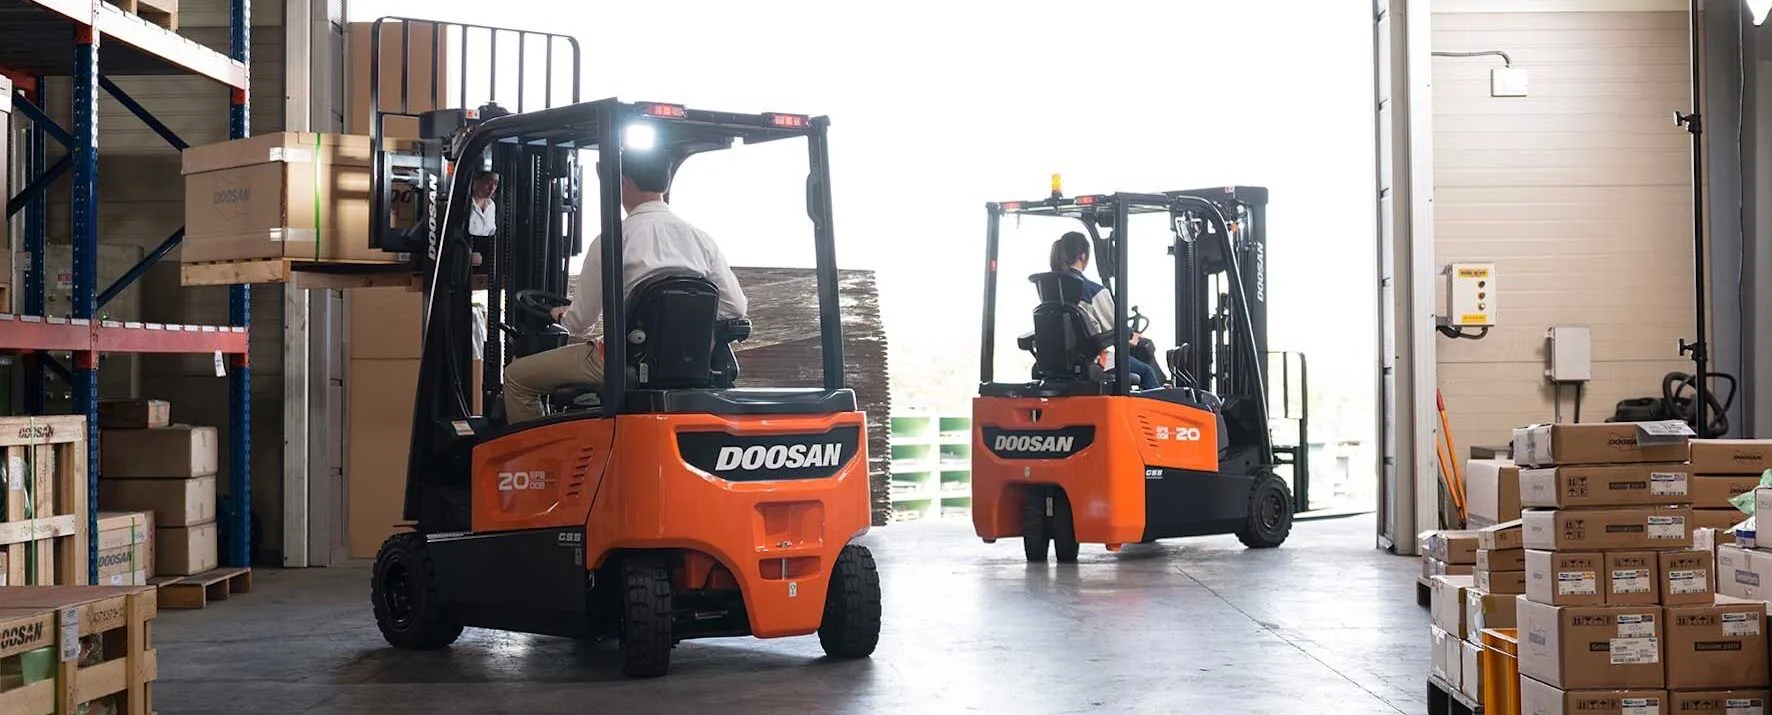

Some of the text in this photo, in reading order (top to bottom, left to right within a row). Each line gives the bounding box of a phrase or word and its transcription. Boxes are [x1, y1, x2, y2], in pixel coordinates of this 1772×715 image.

[214, 188, 251, 204] DOOSAN
[428, 173, 438, 261] DOOSAN
[1175, 427, 1200, 441] 20
[994, 435, 1074, 452] DOOSAN
[715, 443, 842, 471] DOOSAN
[498, 471, 529, 490] 20
[558, 533, 581, 541] GSS
[98, 551, 132, 567] DOOSAN
